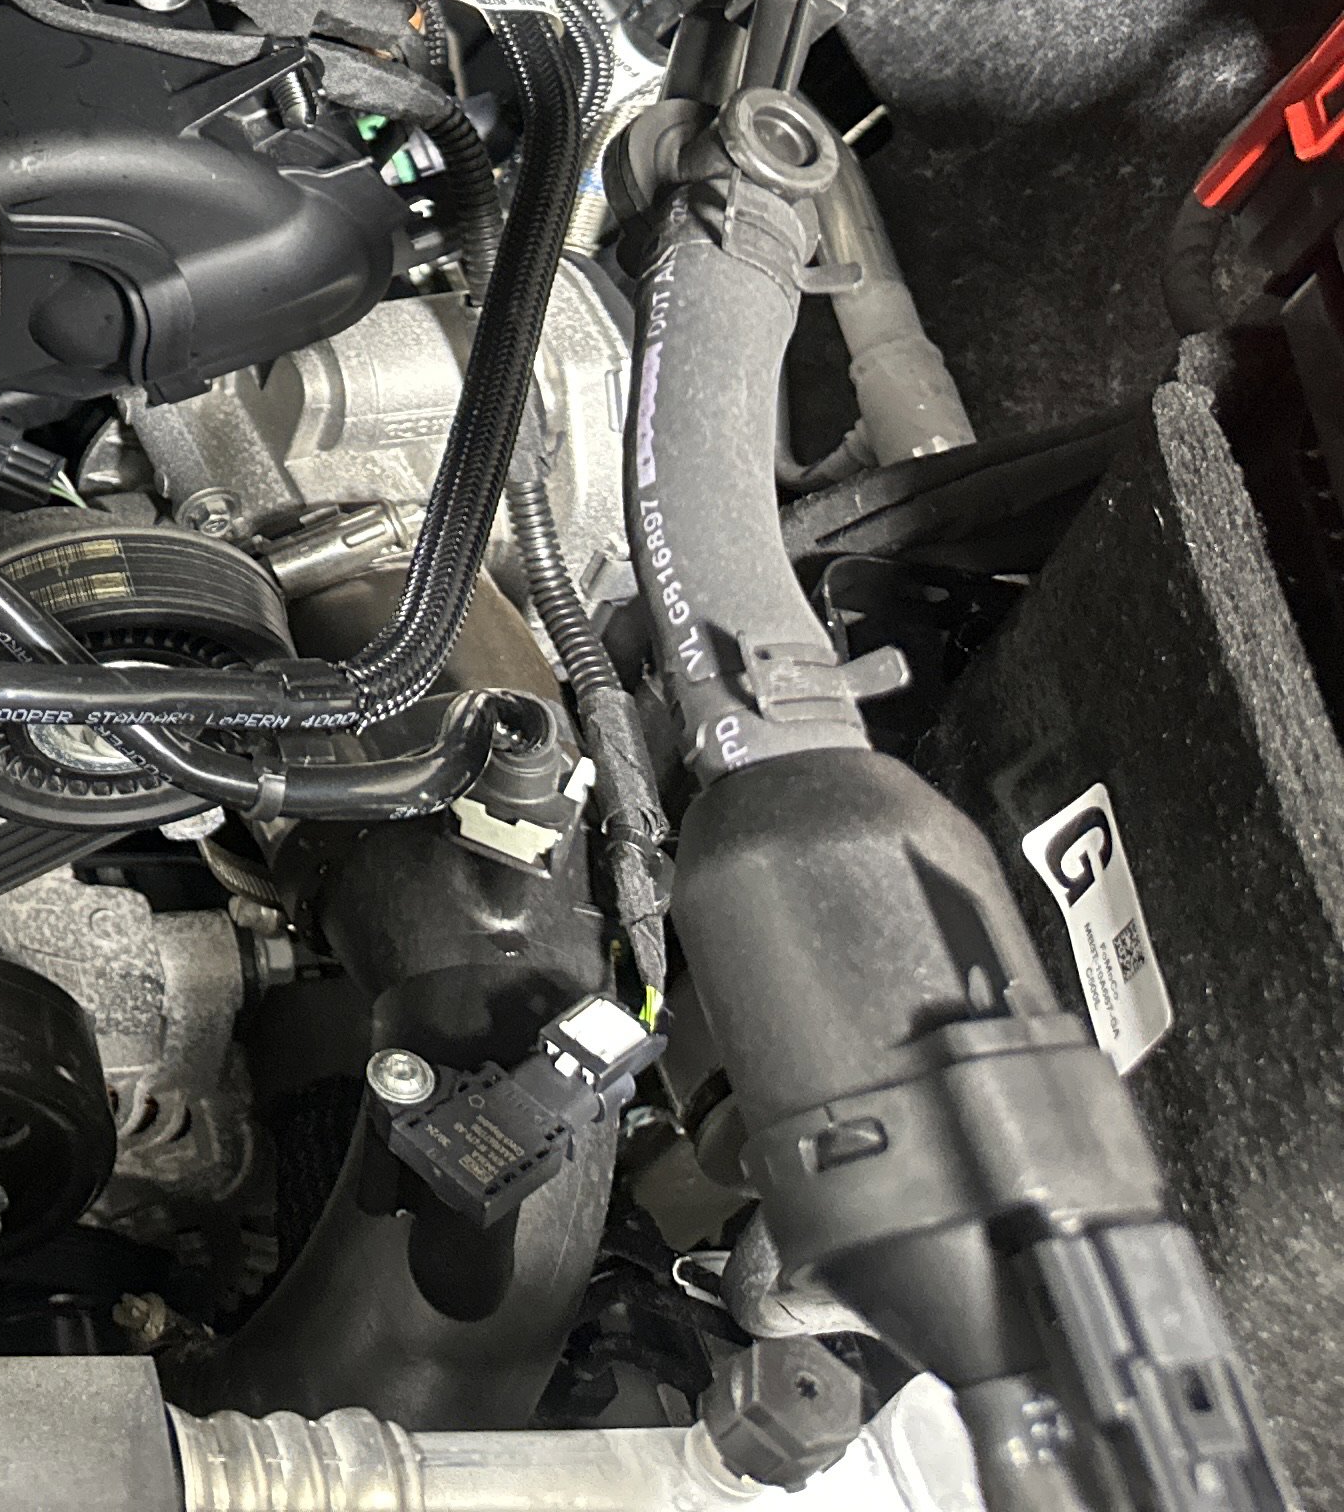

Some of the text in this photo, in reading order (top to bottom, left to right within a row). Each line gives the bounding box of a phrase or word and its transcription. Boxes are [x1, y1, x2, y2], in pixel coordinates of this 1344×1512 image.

[642, 496, 691, 630] GB16897
[205, 712, 292, 731] LoPERM
[299, 711, 359, 731] 4000
[1044, 805, 1114, 909] G
[1100, 940, 1120, 1002] FoMoCo
